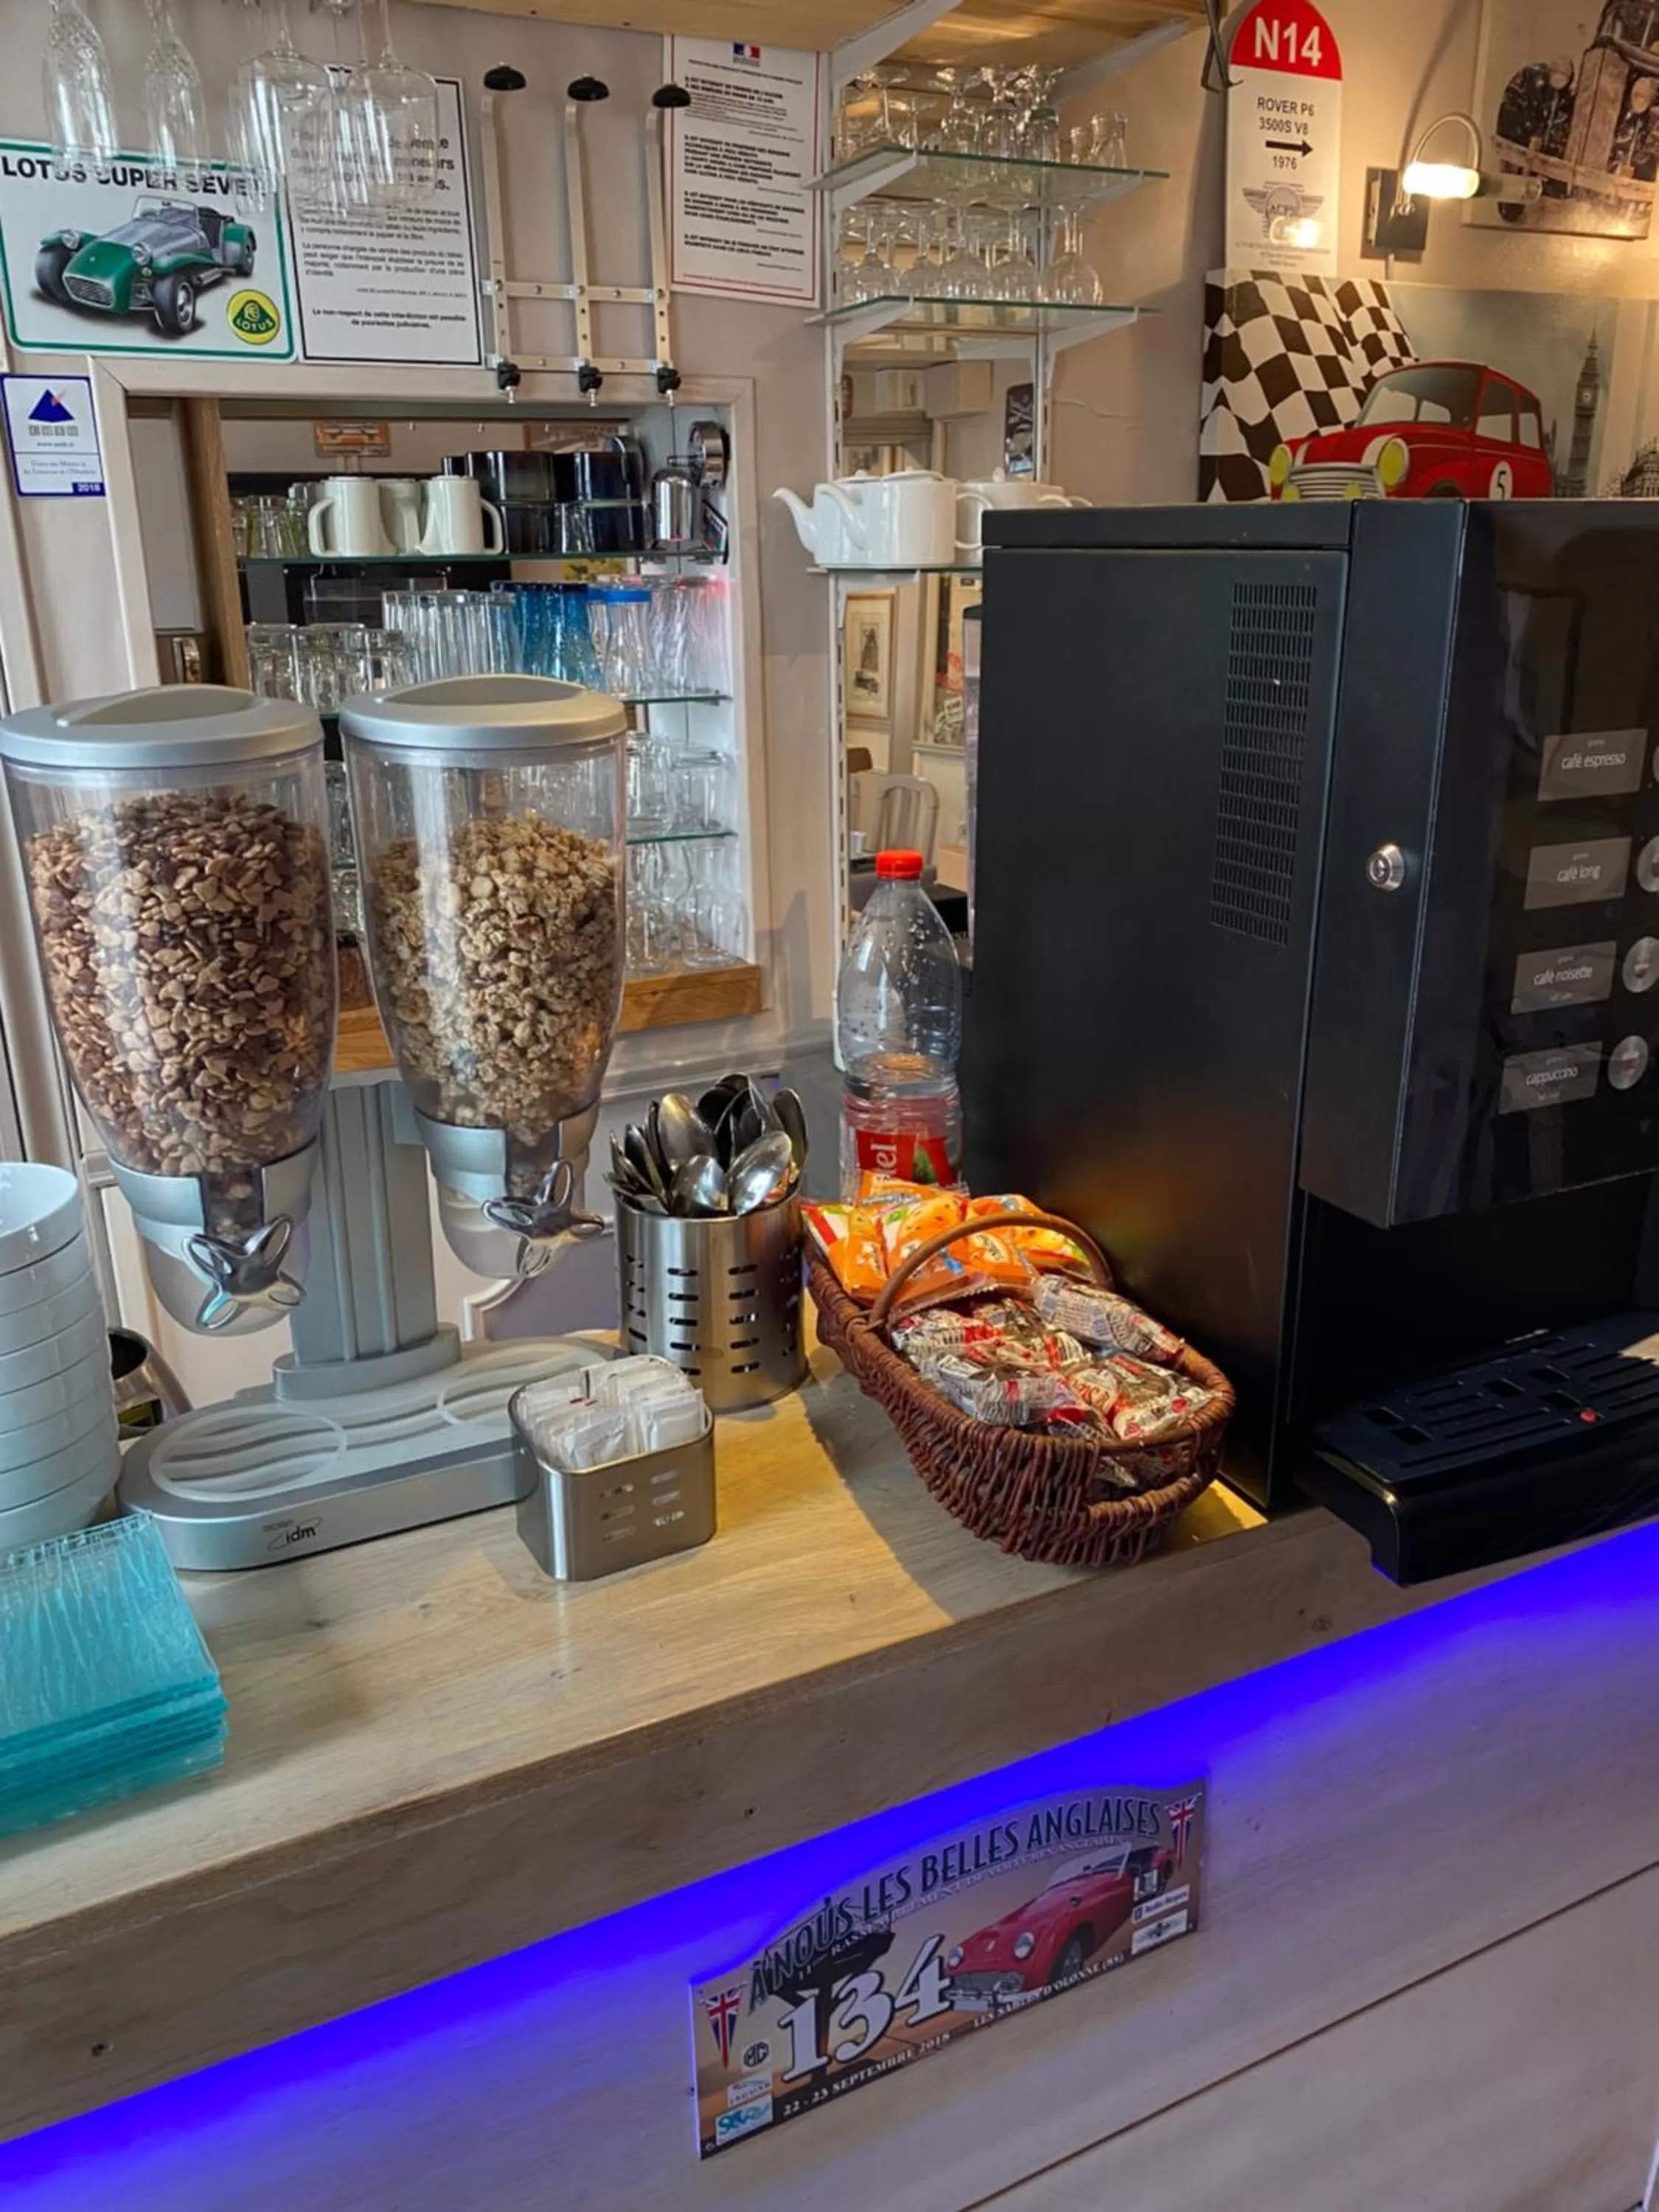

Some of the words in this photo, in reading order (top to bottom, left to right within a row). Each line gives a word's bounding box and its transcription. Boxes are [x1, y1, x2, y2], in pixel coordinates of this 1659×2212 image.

[1254, 16, 1322, 67] N14
[1256, 96, 1298, 115] ROVER
[1301, 100, 1315, 116] P6
[1258, 116, 1292, 133] 3500S
[1295, 122, 1310, 136] V8
[1272, 155, 1298, 170] 1976
[236, 317, 274, 331] LOTUS
[1496, 470, 1508, 499] 5
[1561, 753, 1582, 770] café
[285, 1525, 316, 1544] idm
[773, 1897, 856, 1992] NOUS
[863, 1865, 911, 1921] LES
[921, 1820, 1019, 1892] BELLES
[1026, 1798, 1161, 1851] ANGLAISES
[777, 1933, 951, 2084] 134
[783, 2101, 801, 2116] 22
[812, 2089, 830, 2104] 23
[832, 2048, 915, 2096] SEPTEMBRE
[919, 2031, 951, 2054] 2018
